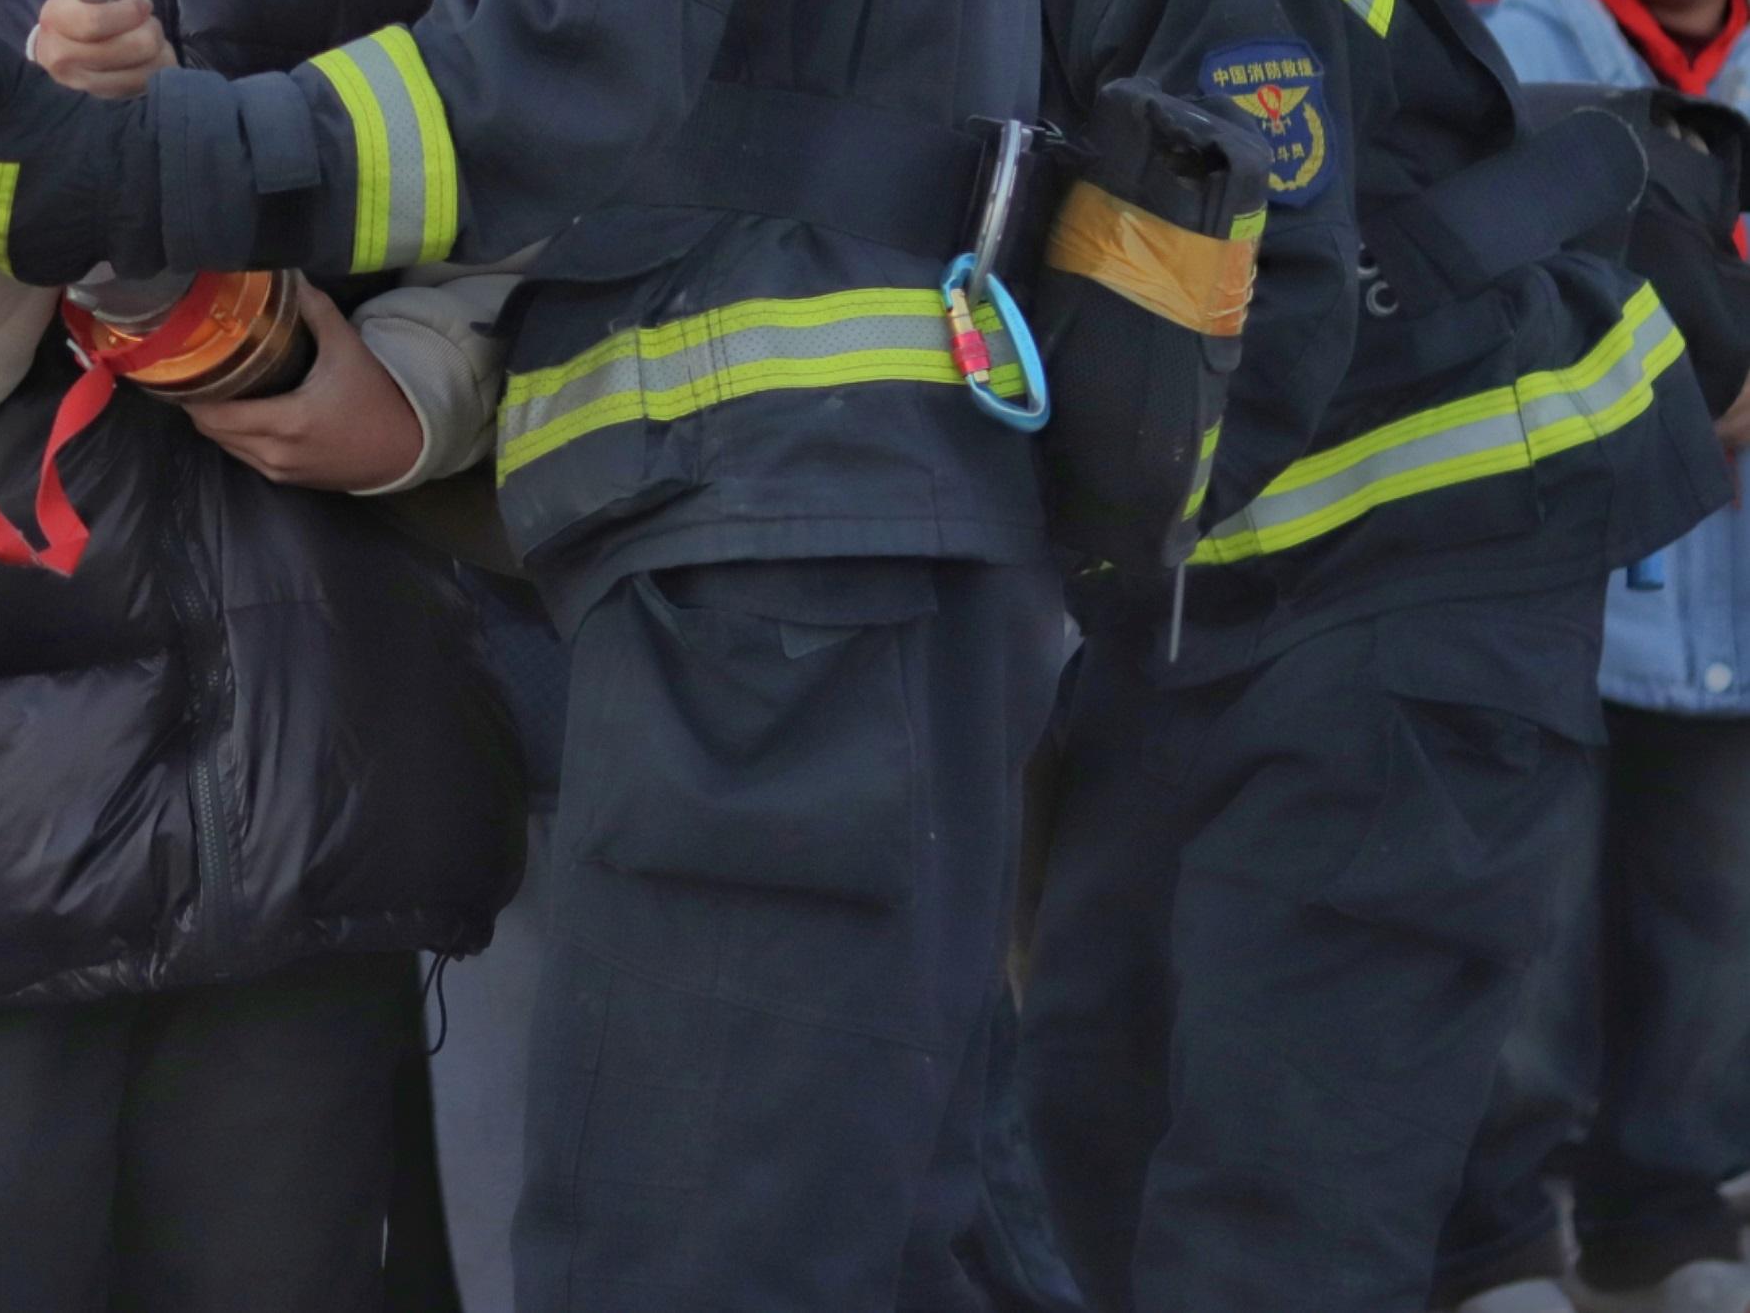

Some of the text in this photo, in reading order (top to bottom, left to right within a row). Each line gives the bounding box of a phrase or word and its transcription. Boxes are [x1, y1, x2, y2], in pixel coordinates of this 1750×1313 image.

[1213, 58, 1313, 87] 中国消防救援
[1271, 143, 1305, 163] 斗员
